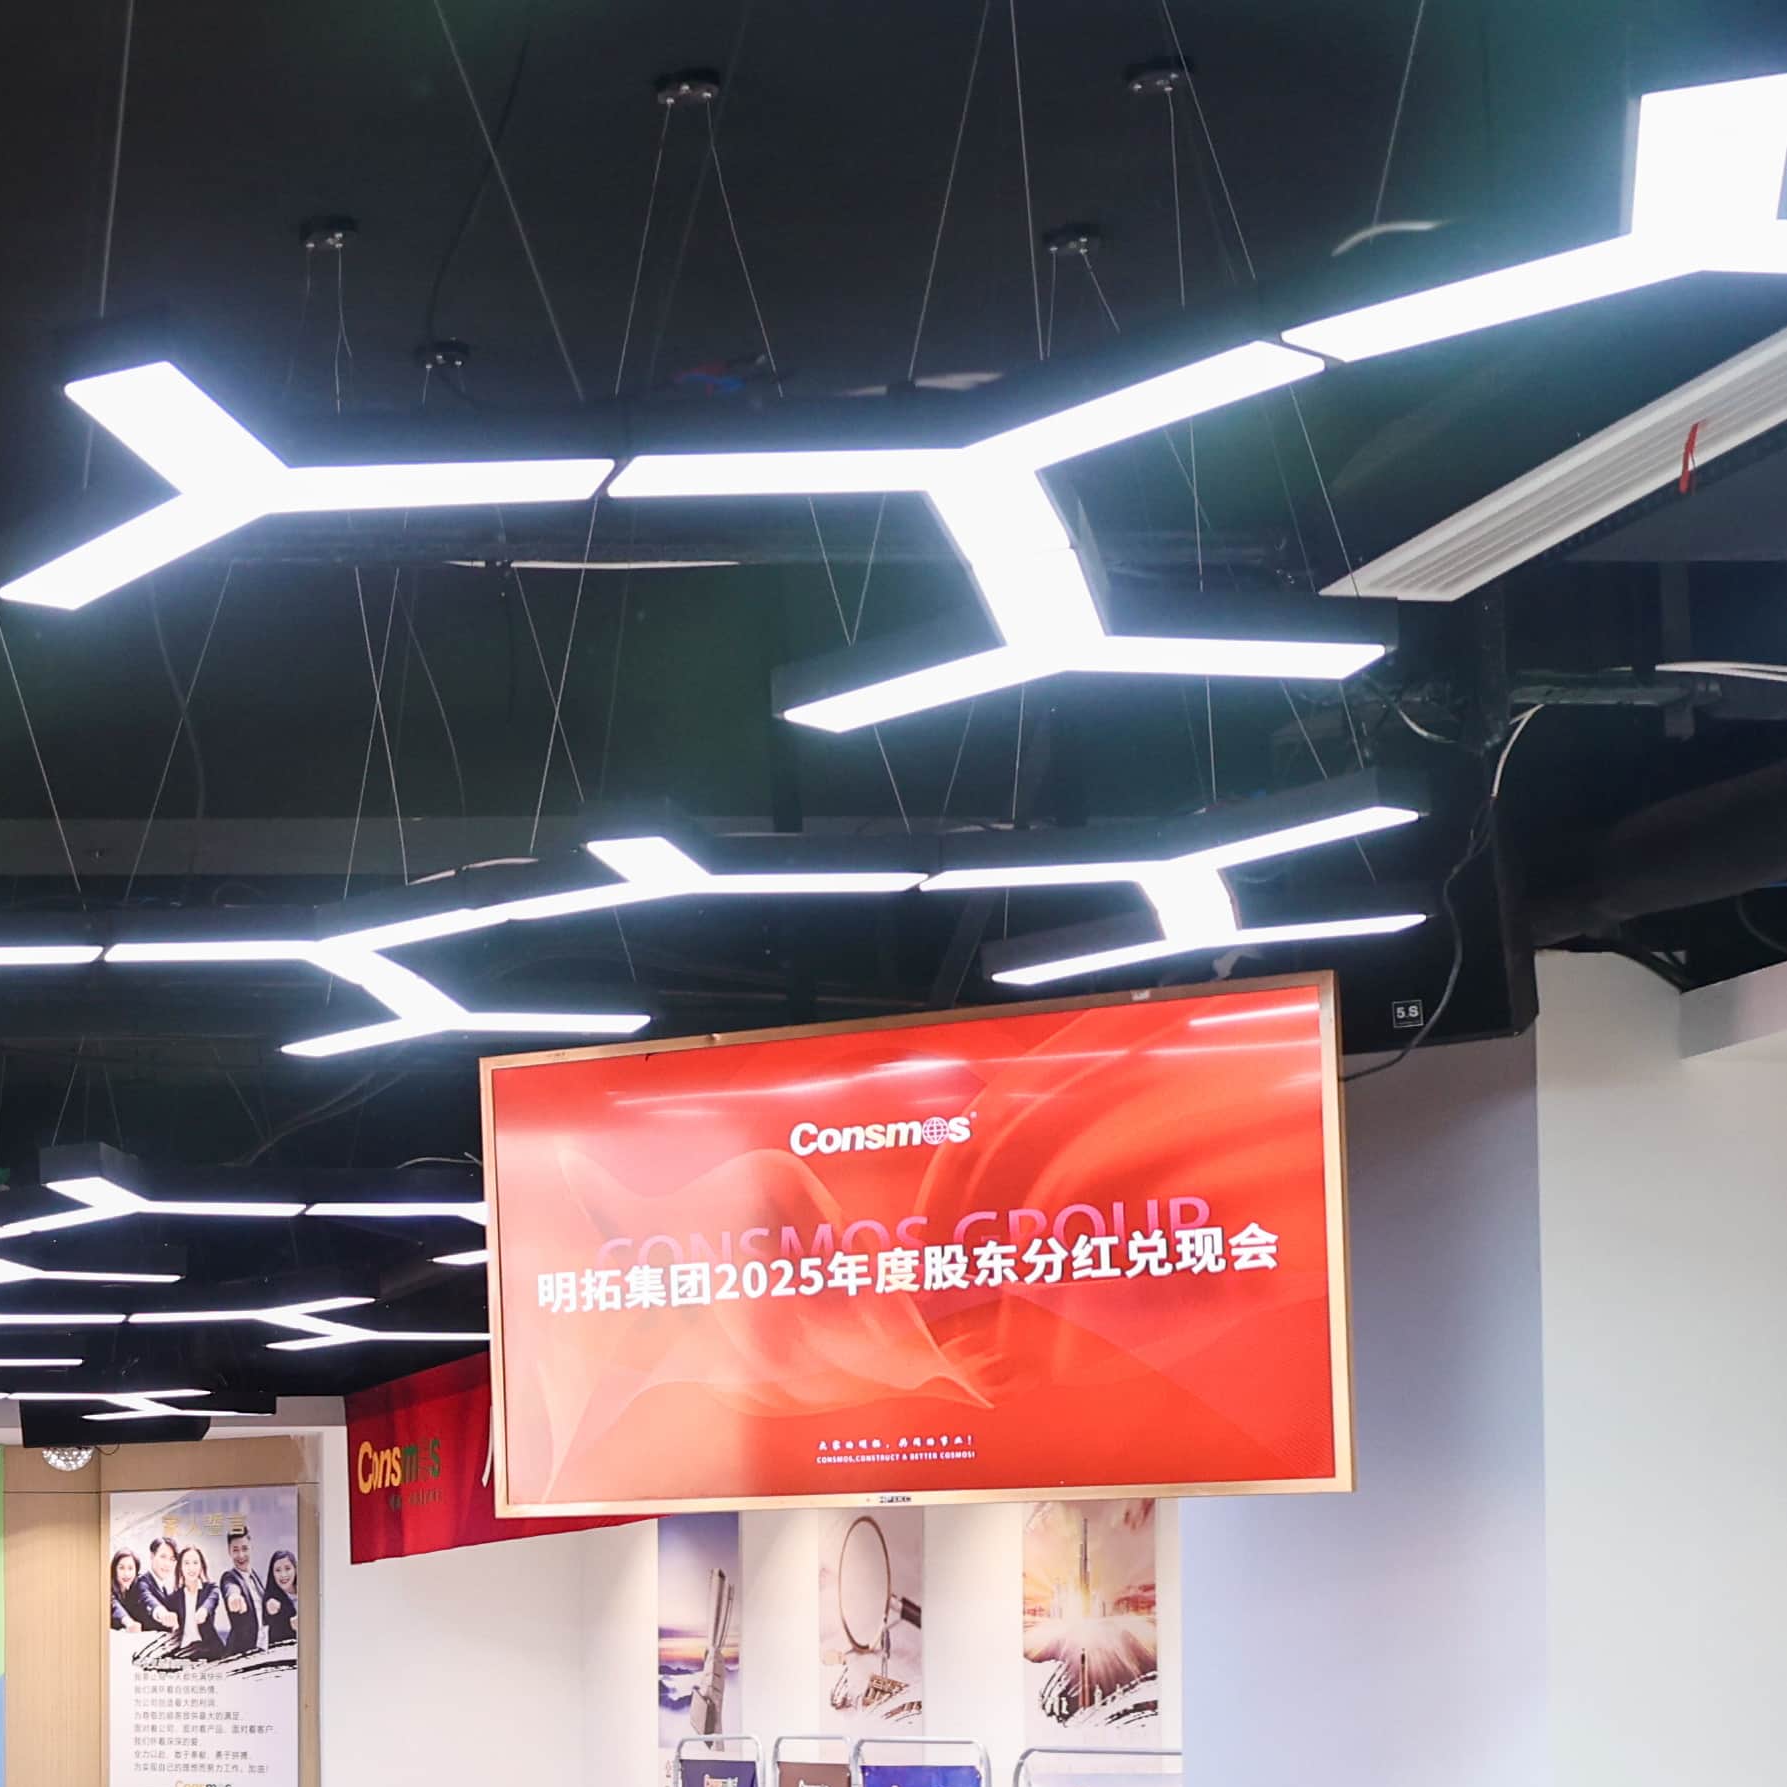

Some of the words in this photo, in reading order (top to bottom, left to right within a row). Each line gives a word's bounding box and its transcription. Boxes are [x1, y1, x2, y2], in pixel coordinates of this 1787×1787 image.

[789, 1114, 974, 1156] Consmos
[536, 1221, 1281, 1315] 明拓集团2025年度股东分红兑现会
